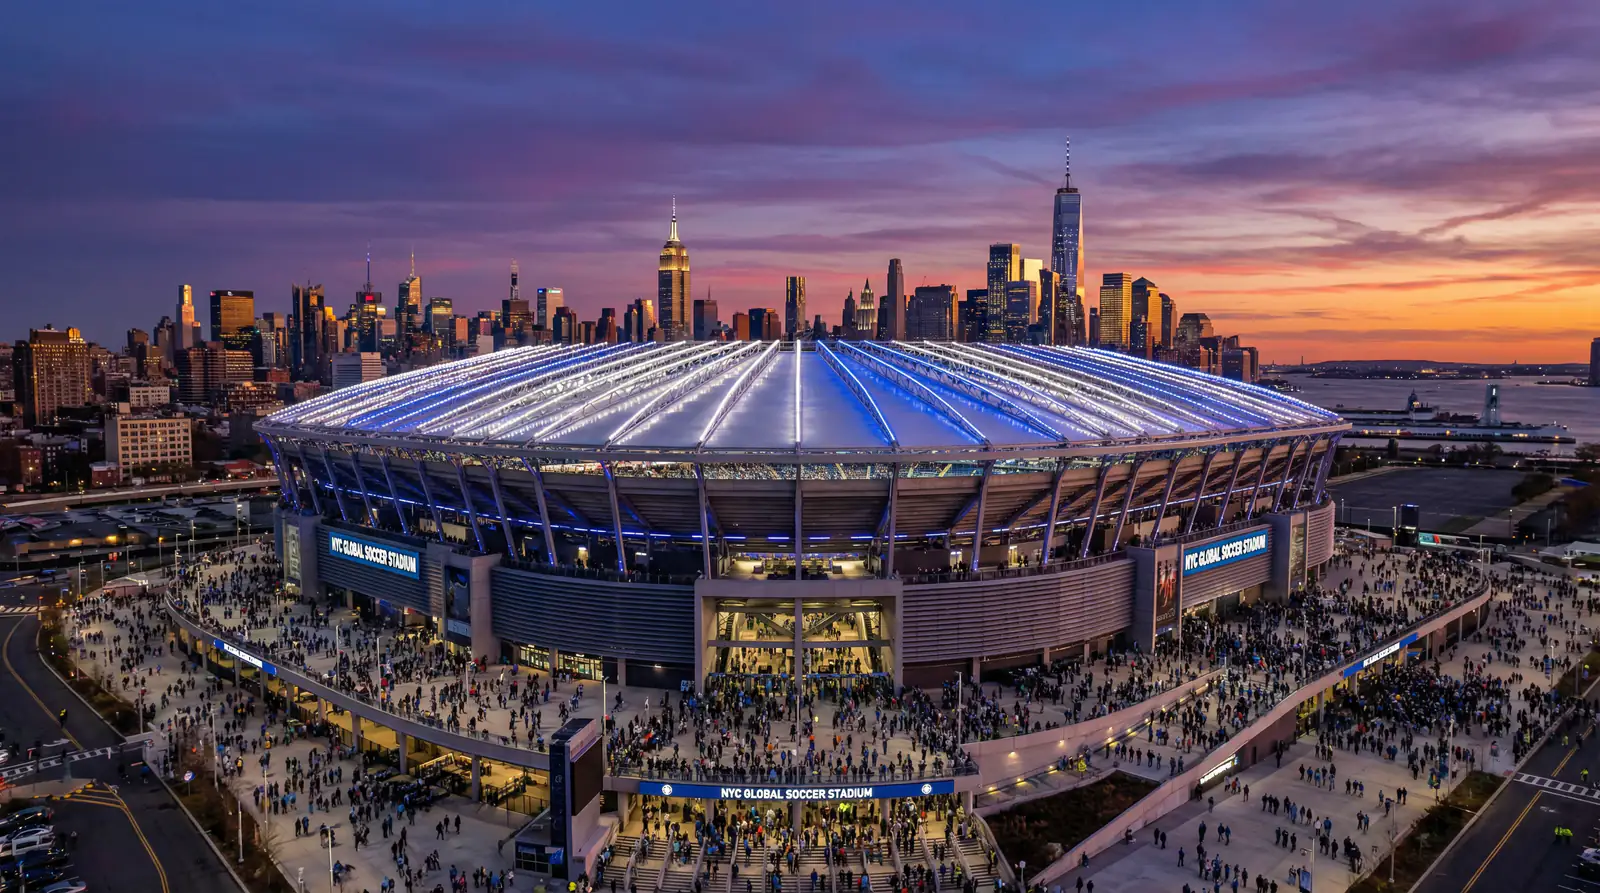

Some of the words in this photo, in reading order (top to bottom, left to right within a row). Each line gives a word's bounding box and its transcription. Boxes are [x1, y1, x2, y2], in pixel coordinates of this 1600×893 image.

[332, 537, 342, 552] NYC
[343, 540, 364, 559] GLOBAL
[364, 545, 387, 565] SOCCER
[388, 551, 416, 573] STADIUM
[1185, 552, 1198, 570] NYC
[1199, 547, 1221, 566] GLOBAL
[1222, 541, 1242, 560] SOCCER
[1243, 534, 1266, 554] STADIUM
[721, 788, 741, 798] NYC
[743, 788, 783, 799] GLOBAL
[786, 789, 826, 799] SOCCER
[828, 788, 872, 798] STADIUM
